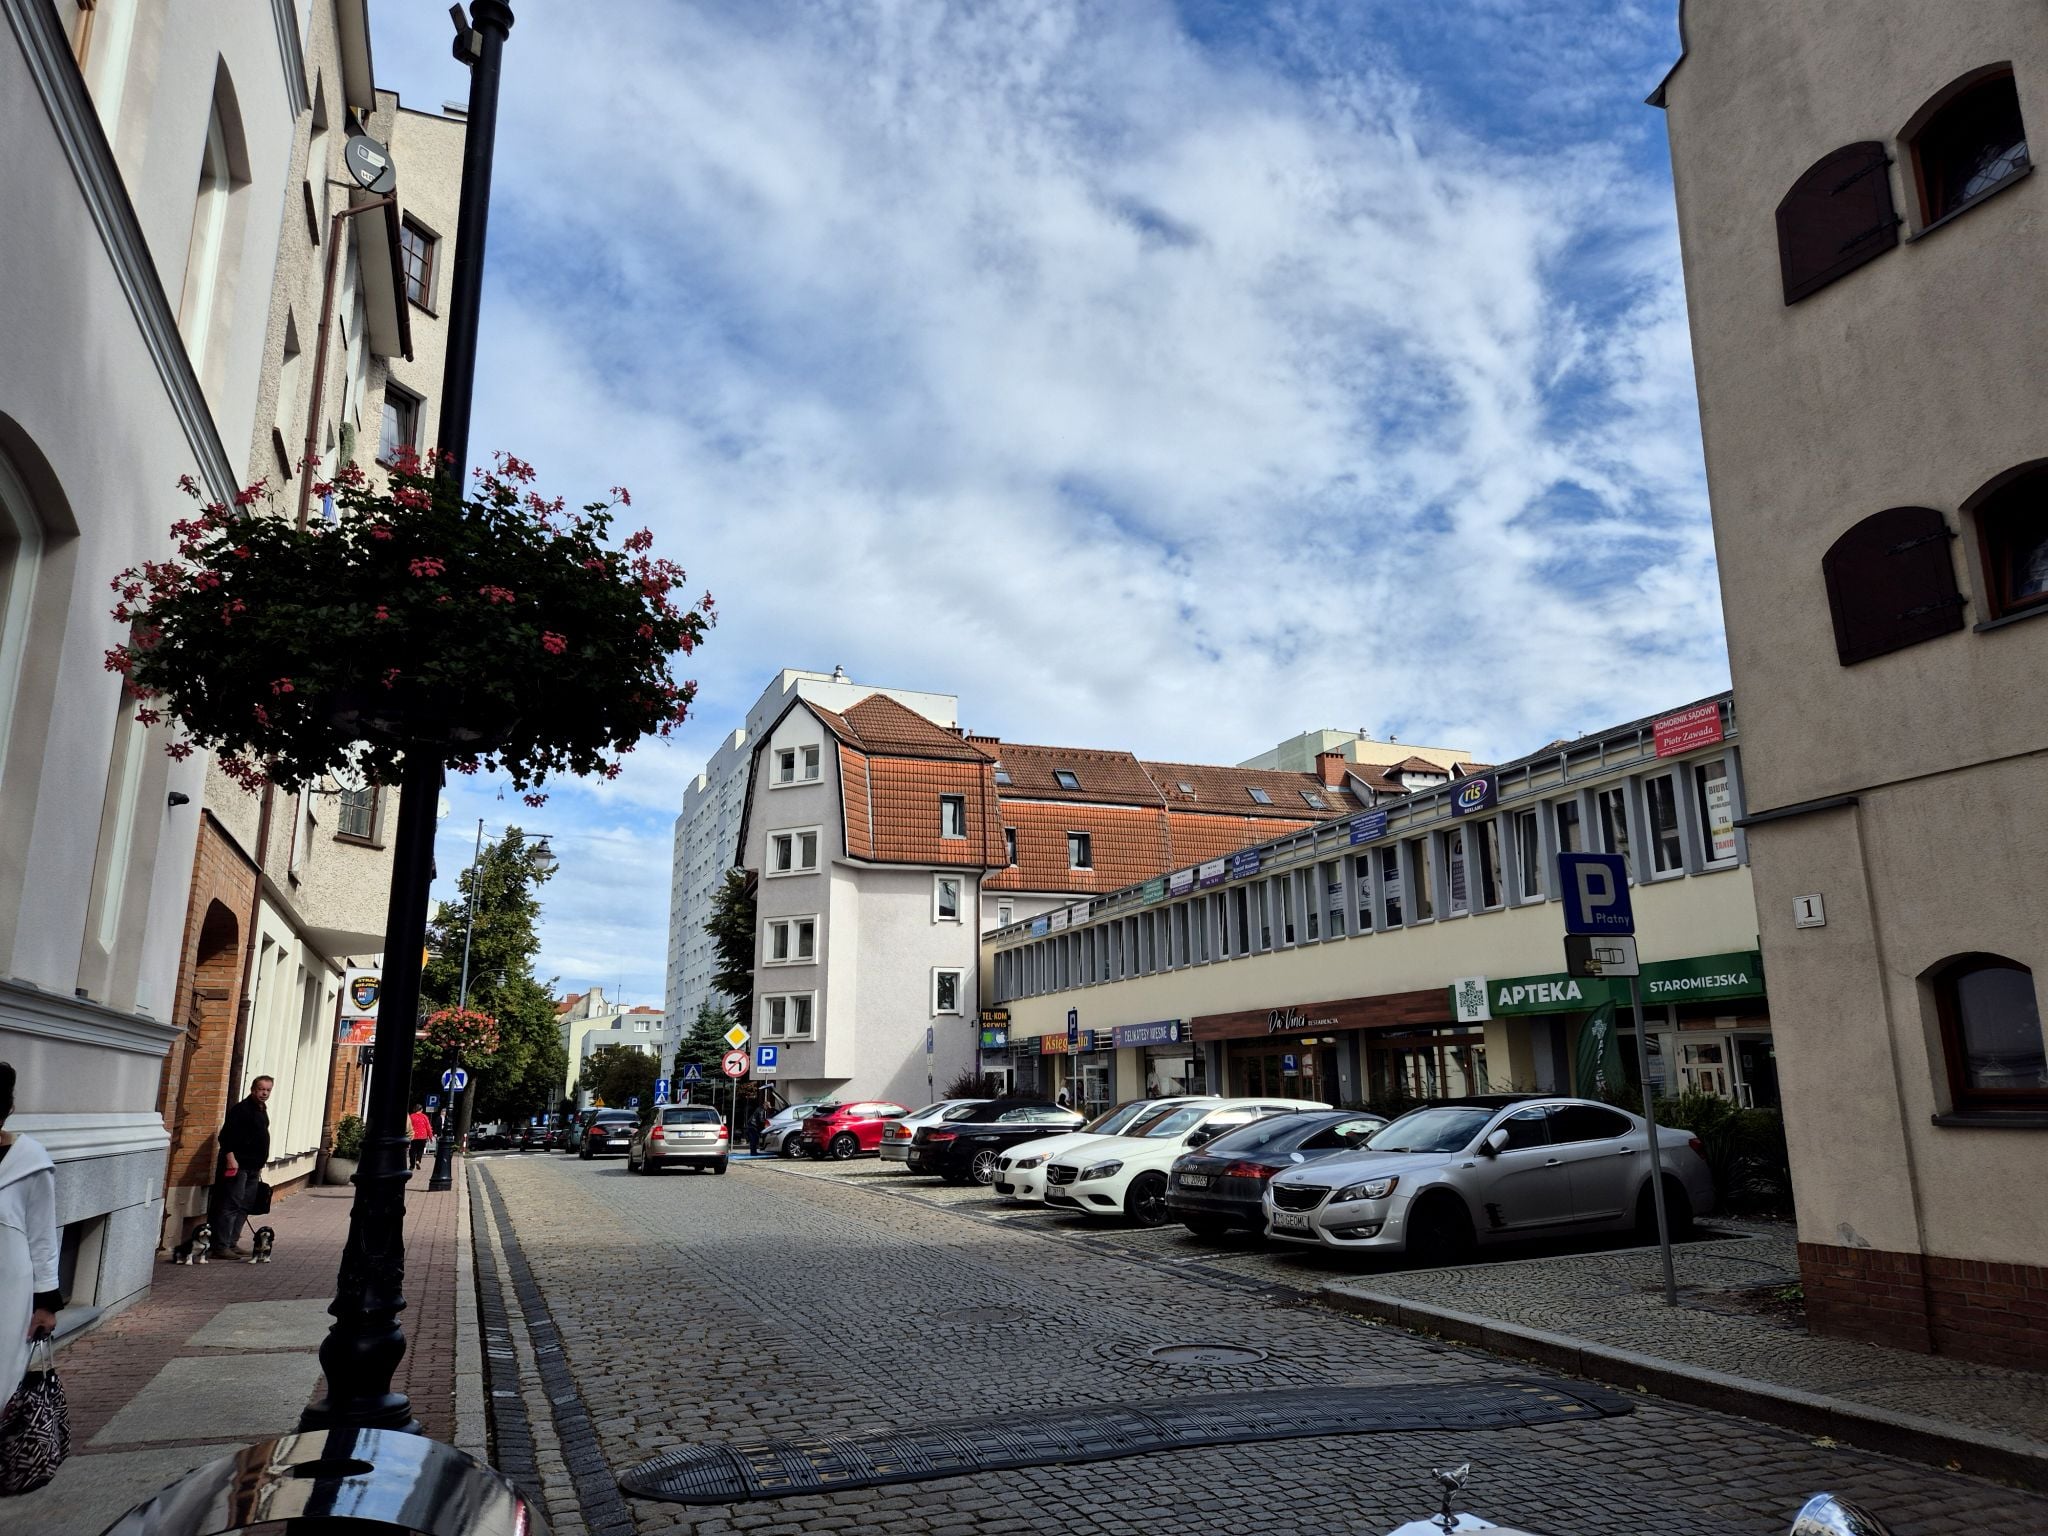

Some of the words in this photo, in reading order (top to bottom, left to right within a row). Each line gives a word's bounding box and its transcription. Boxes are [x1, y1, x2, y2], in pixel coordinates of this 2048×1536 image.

[1655, 713, 1688, 730] KOMORNIK
[1688, 704, 1716, 720] SĄDOWY
[1663, 735, 1682, 747] Piotr
[1682, 725, 1714, 741] Zawada
[1465, 784, 1481, 801] ris
[1464, 804, 1484, 814] REKLAMY
[1575, 862, 1616, 924] P
[1803, 898, 1817, 919] 1
[1595, 912, 1631, 928] Płatny
[1498, 980, 1583, 1006] APTEKA
[1649, 972, 1749, 993] STAROMIEJSKA
[1124, 1028, 1150, 1042] DELIKATESY
[762, 1048, 774, 1064] P
